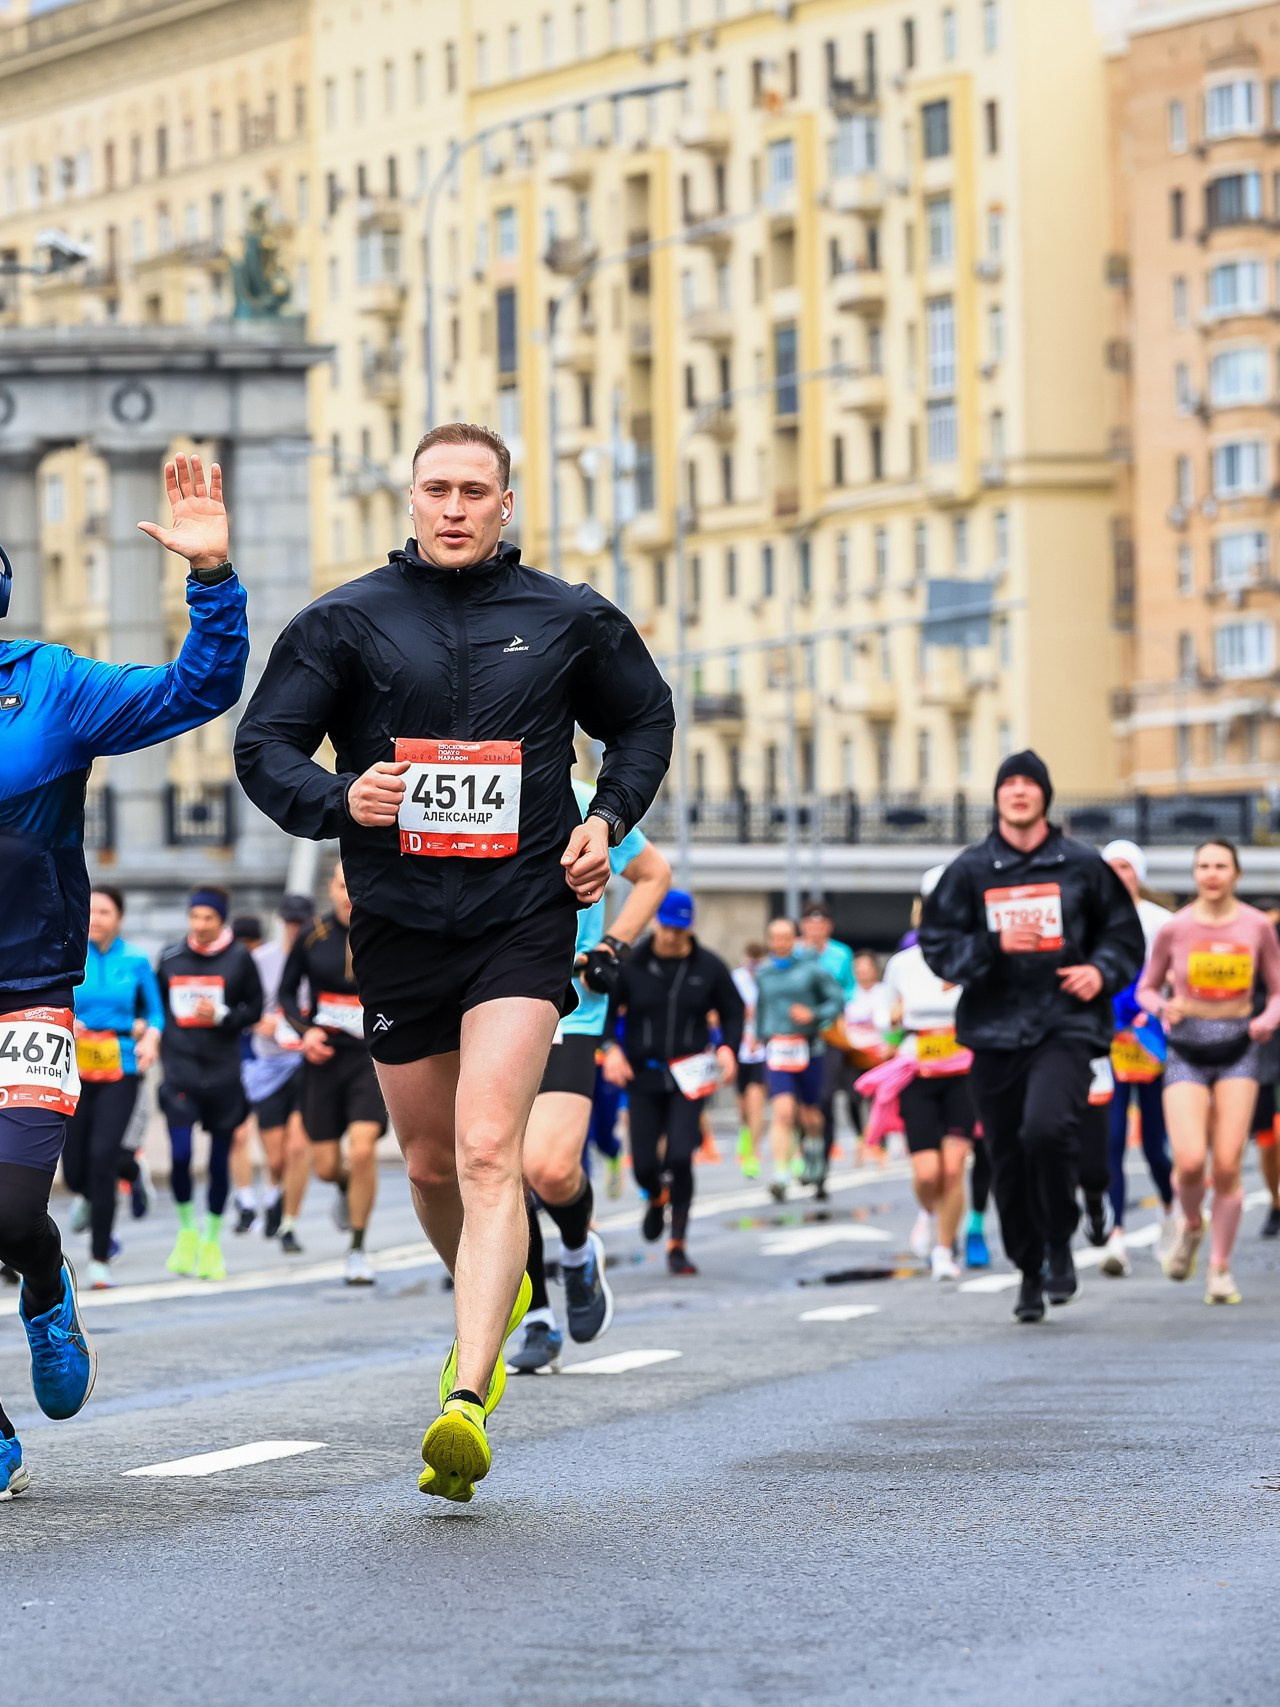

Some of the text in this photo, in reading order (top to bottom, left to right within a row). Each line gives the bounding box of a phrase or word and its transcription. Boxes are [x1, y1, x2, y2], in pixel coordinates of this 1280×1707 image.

[411, 774, 505, 809] 4514
[423, 811, 493, 824] АЛЕКСАНДР
[409, 833, 422, 852] D
[26, 1065, 62, 1079] АНТОН
